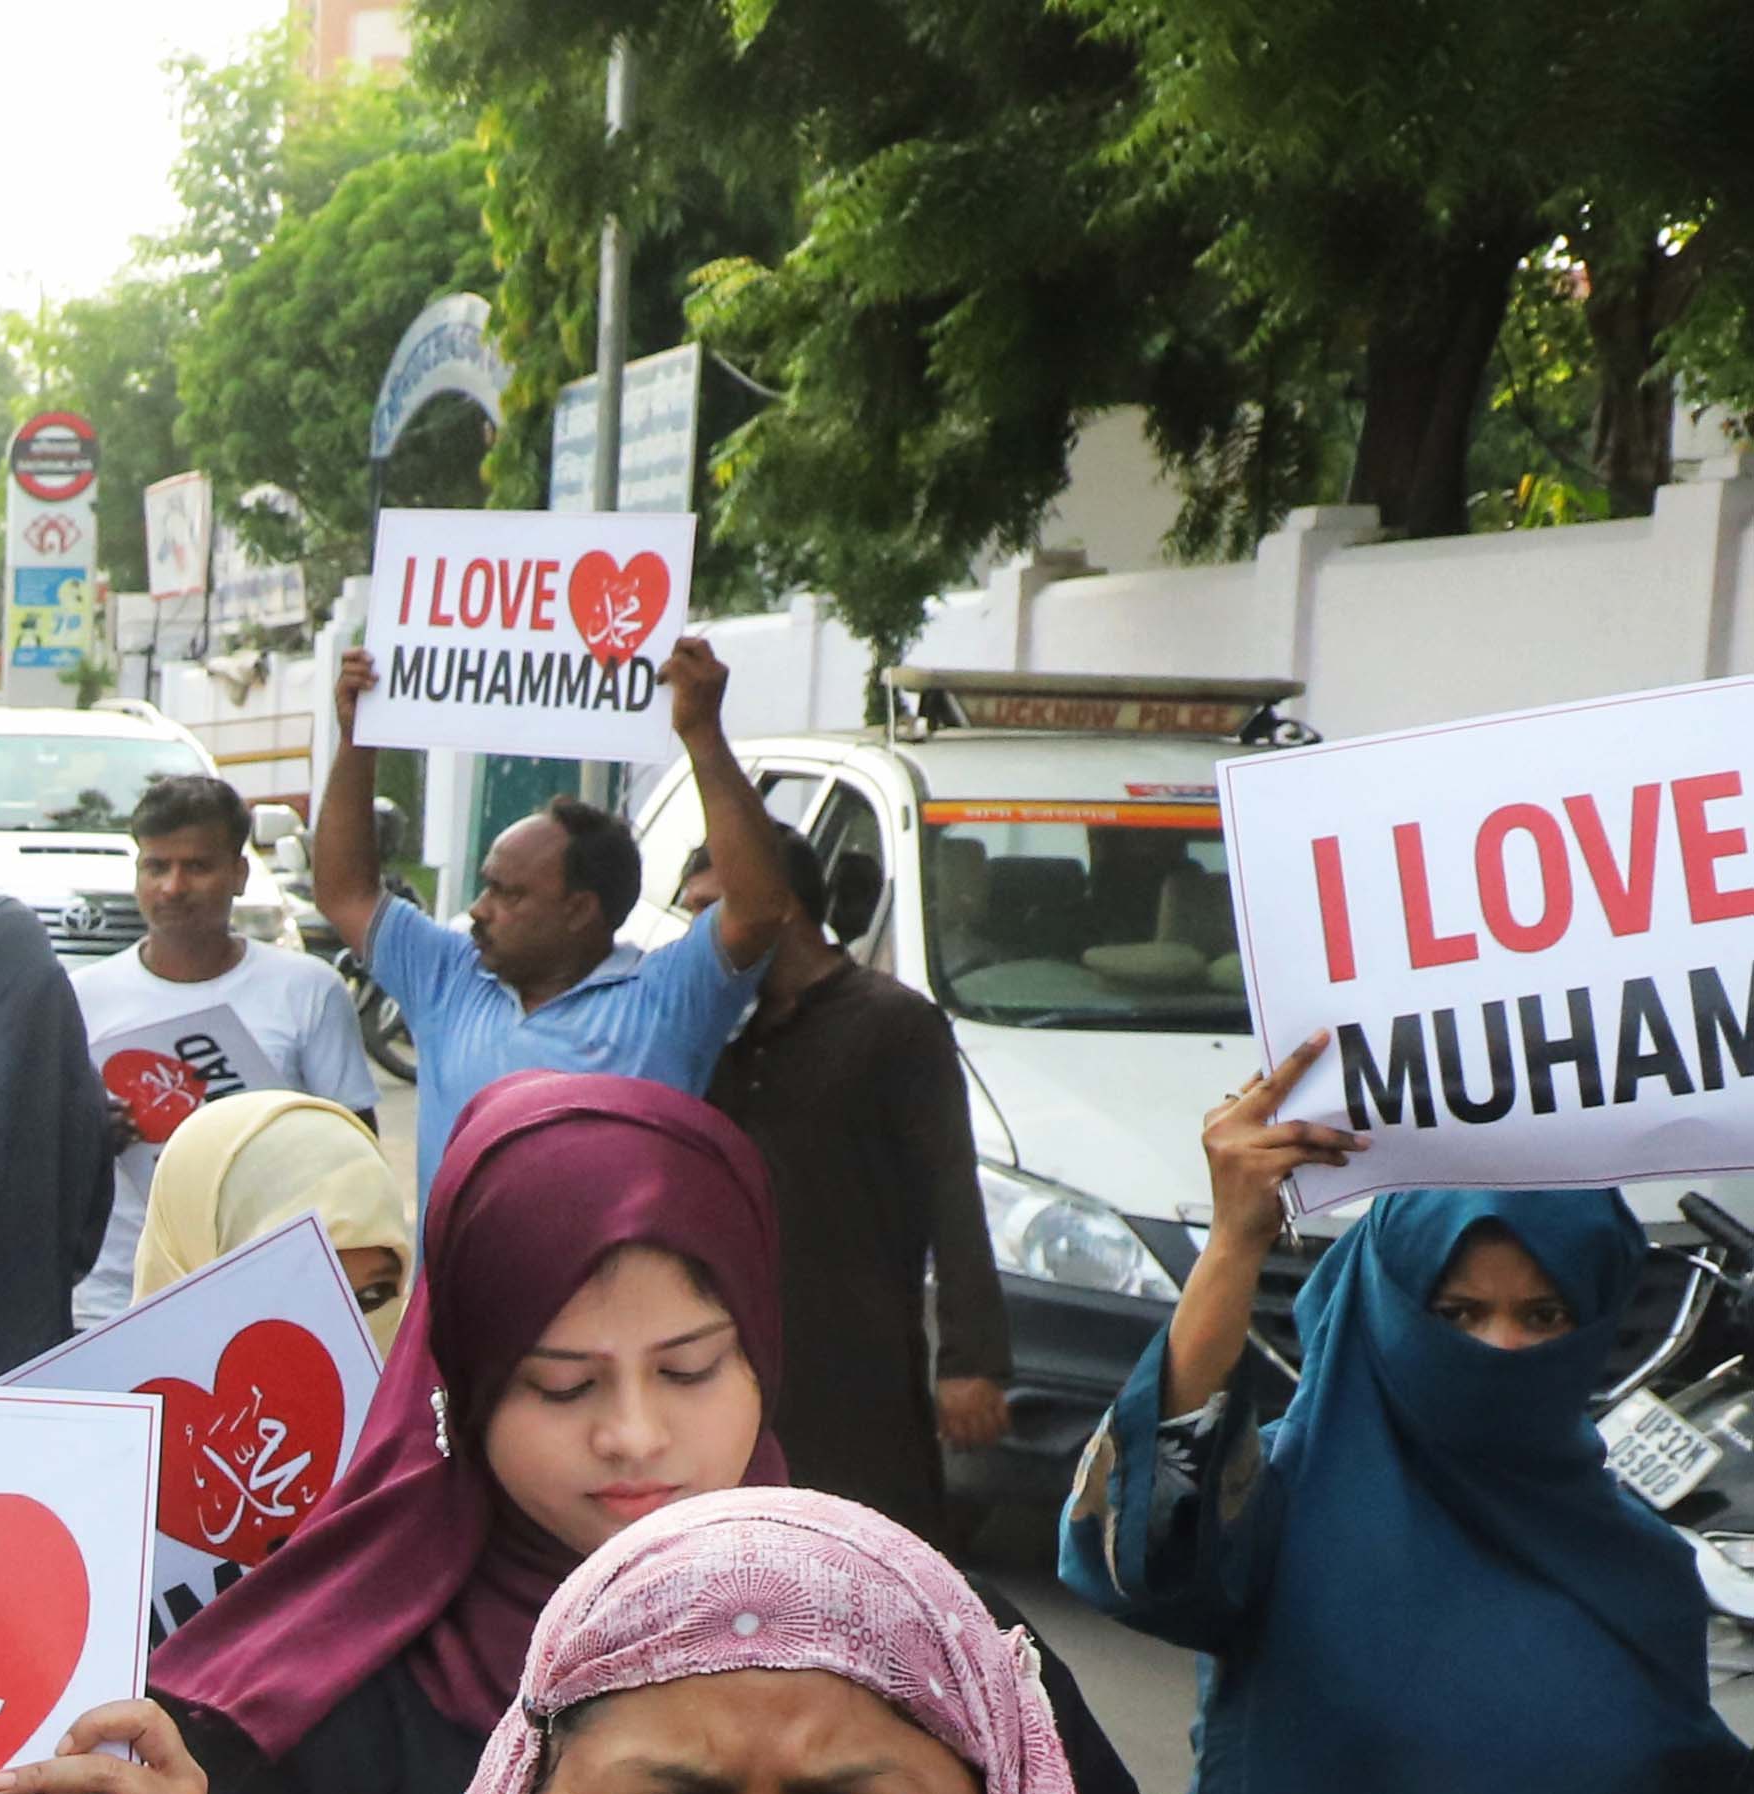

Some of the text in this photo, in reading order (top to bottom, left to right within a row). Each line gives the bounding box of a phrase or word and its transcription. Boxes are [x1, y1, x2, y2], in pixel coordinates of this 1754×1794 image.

[399, 556, 560, 632] I LOVE
[389, 646, 657, 713] MUHAMMAD
[973, 698, 1231, 731] LUCKNOW POLICE
[1311, 770, 1754, 983] I LOVE
